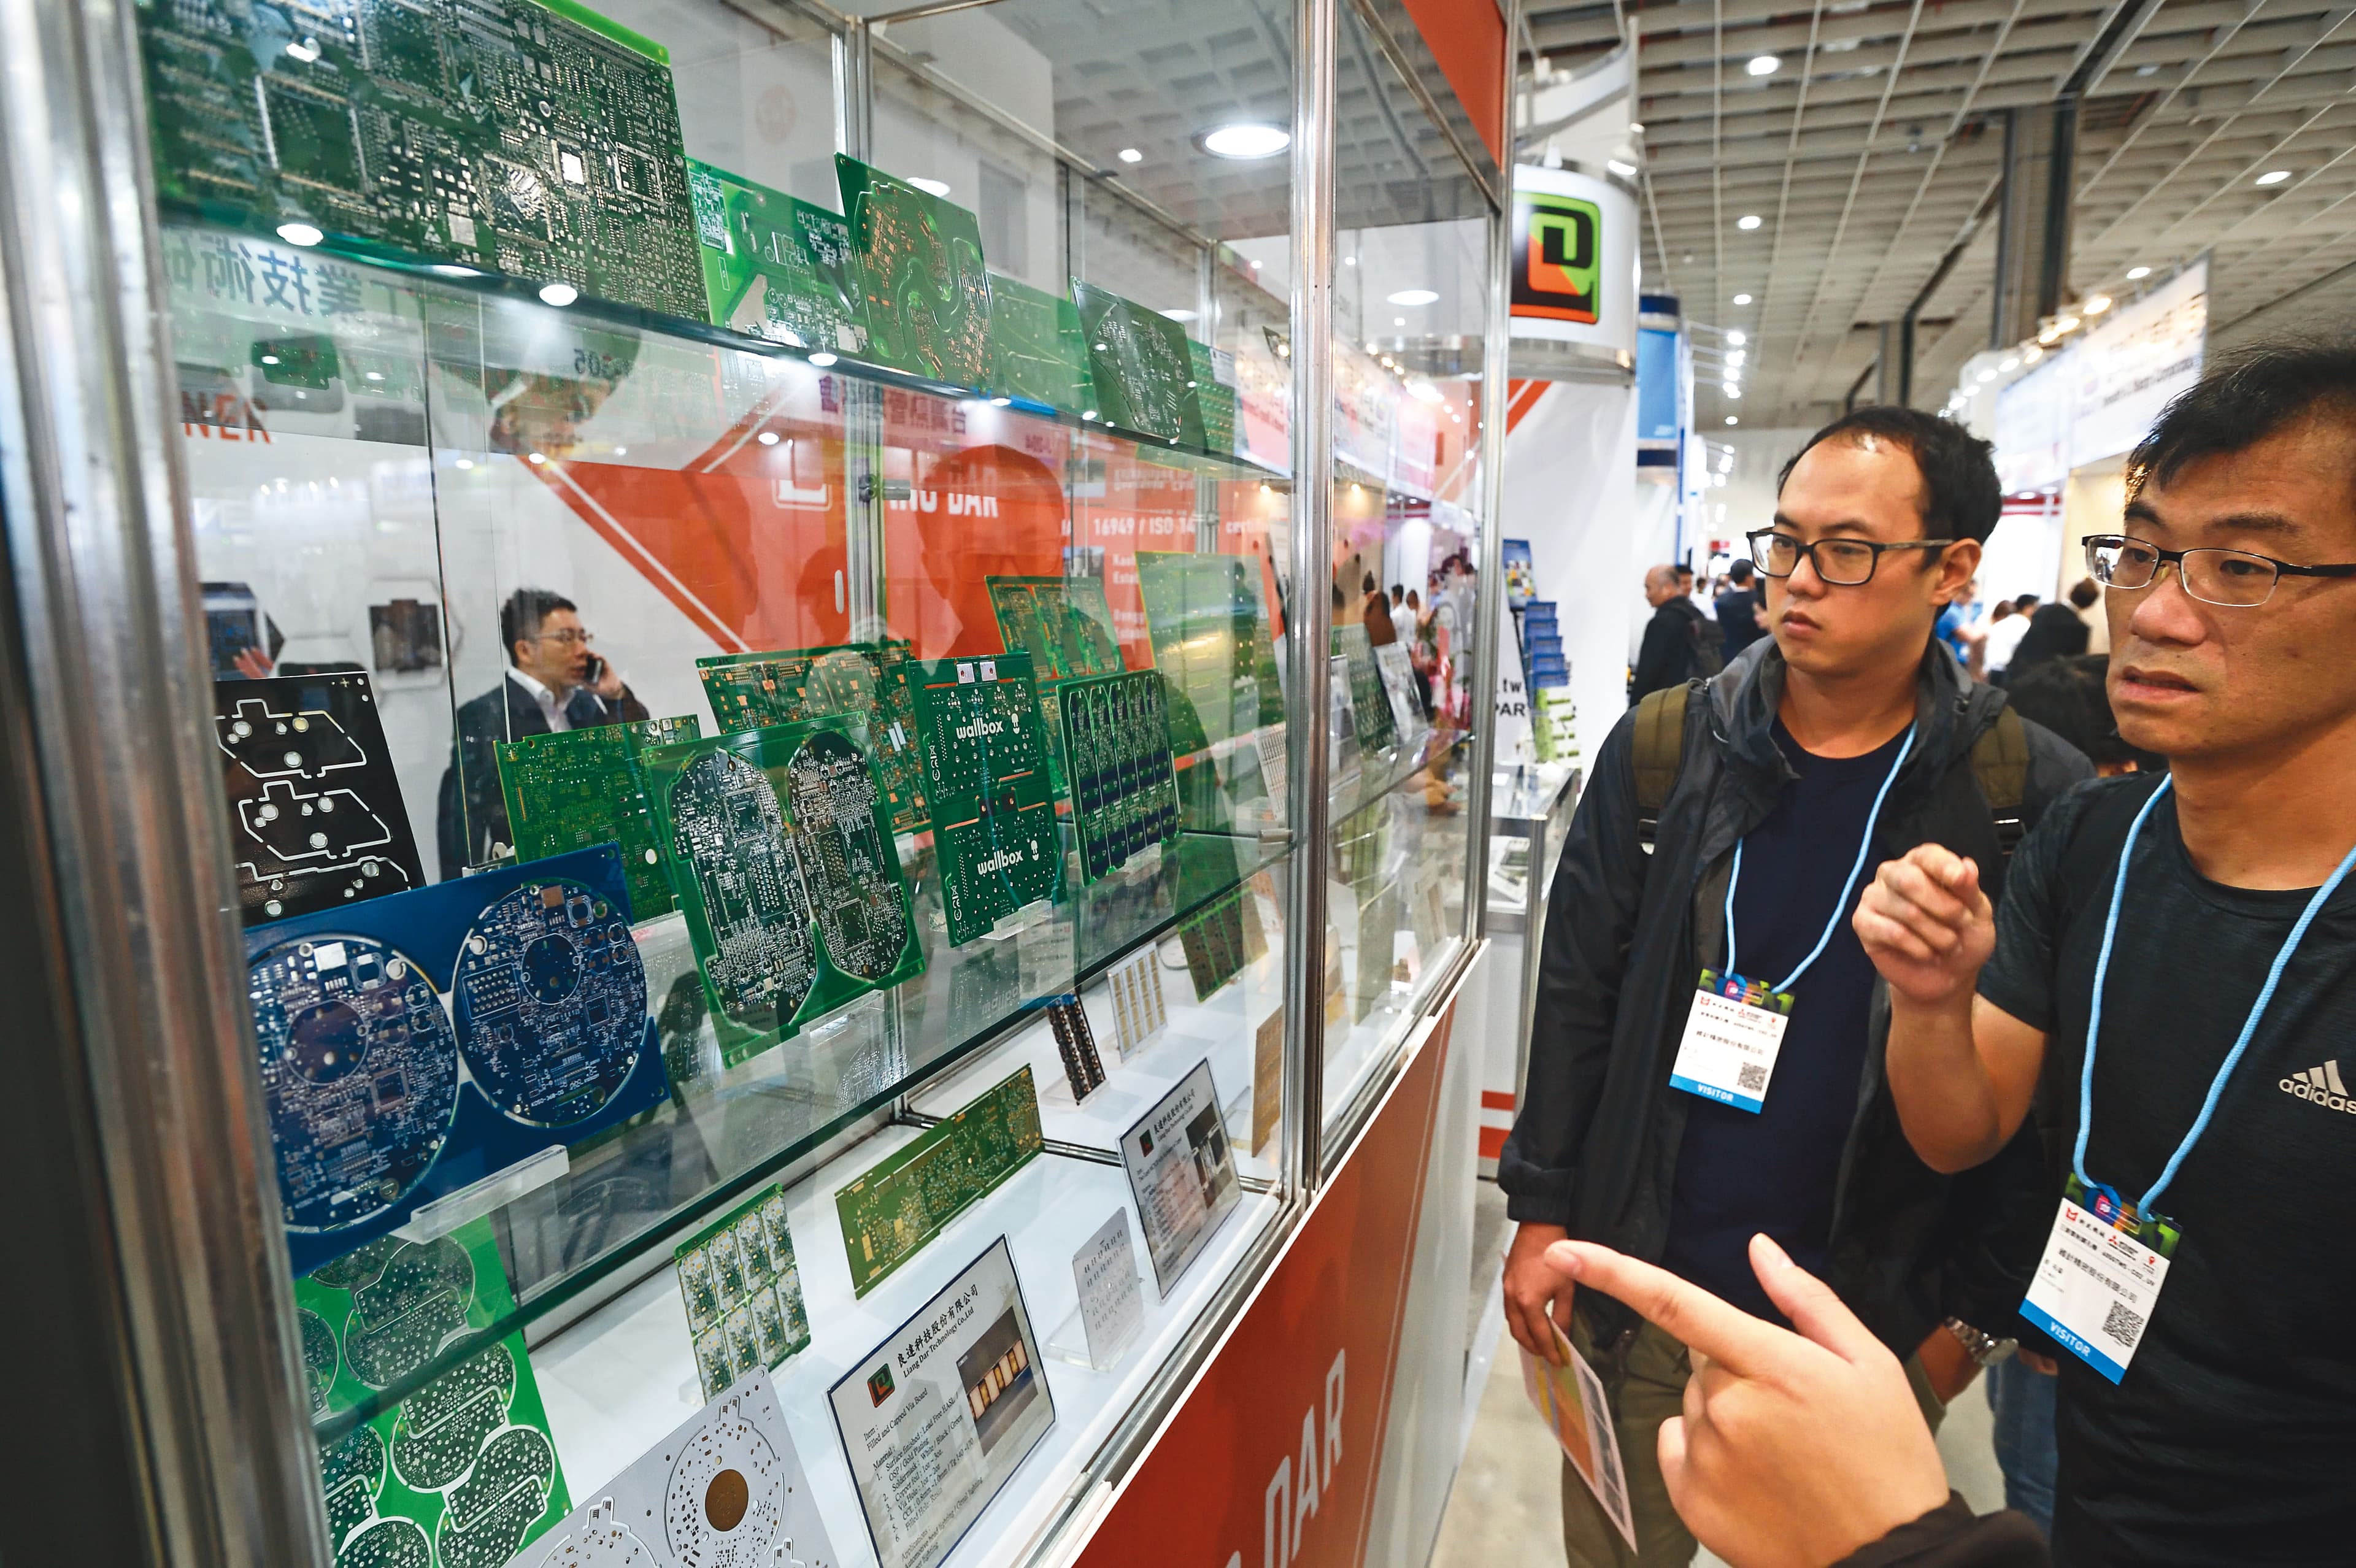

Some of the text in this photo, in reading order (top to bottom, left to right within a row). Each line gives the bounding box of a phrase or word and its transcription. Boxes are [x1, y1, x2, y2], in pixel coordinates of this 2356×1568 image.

[956, 717, 1004, 740] wallbox
[977, 848, 1024, 875] wallbox
[1697, 1083, 1734, 1102] VISITOR
[2278, 1078, 2356, 1115] adidas
[896, 1283, 977, 1369] 良達科技股份有限公司
[2049, 1321, 2092, 1357] VISITOR
[903, 1358, 920, 1378] Liang
[918, 1348, 930, 1362] Dar
[929, 1321, 957, 1353] Technology
[866, 1387, 928, 1451] Filled and Capped Via Board
[920, 1443, 934, 1462] White
[936, 1428, 949, 1445] Black
[950, 1412, 963, 1430] Green
[885, 1449, 903, 1472] Surface
[903, 1431, 920, 1455] finished
[922, 1418, 933, 1434] Lead
[933, 1409, 942, 1423] Free
[888, 1466, 900, 1482] OSP
[902, 1451, 914, 1467] Gold
[895, 1481, 912, 1503] Copper
[911, 1471, 920, 1485] foil
[898, 1498, 907, 1512] Via
[906, 1486, 918, 1502] Hole
